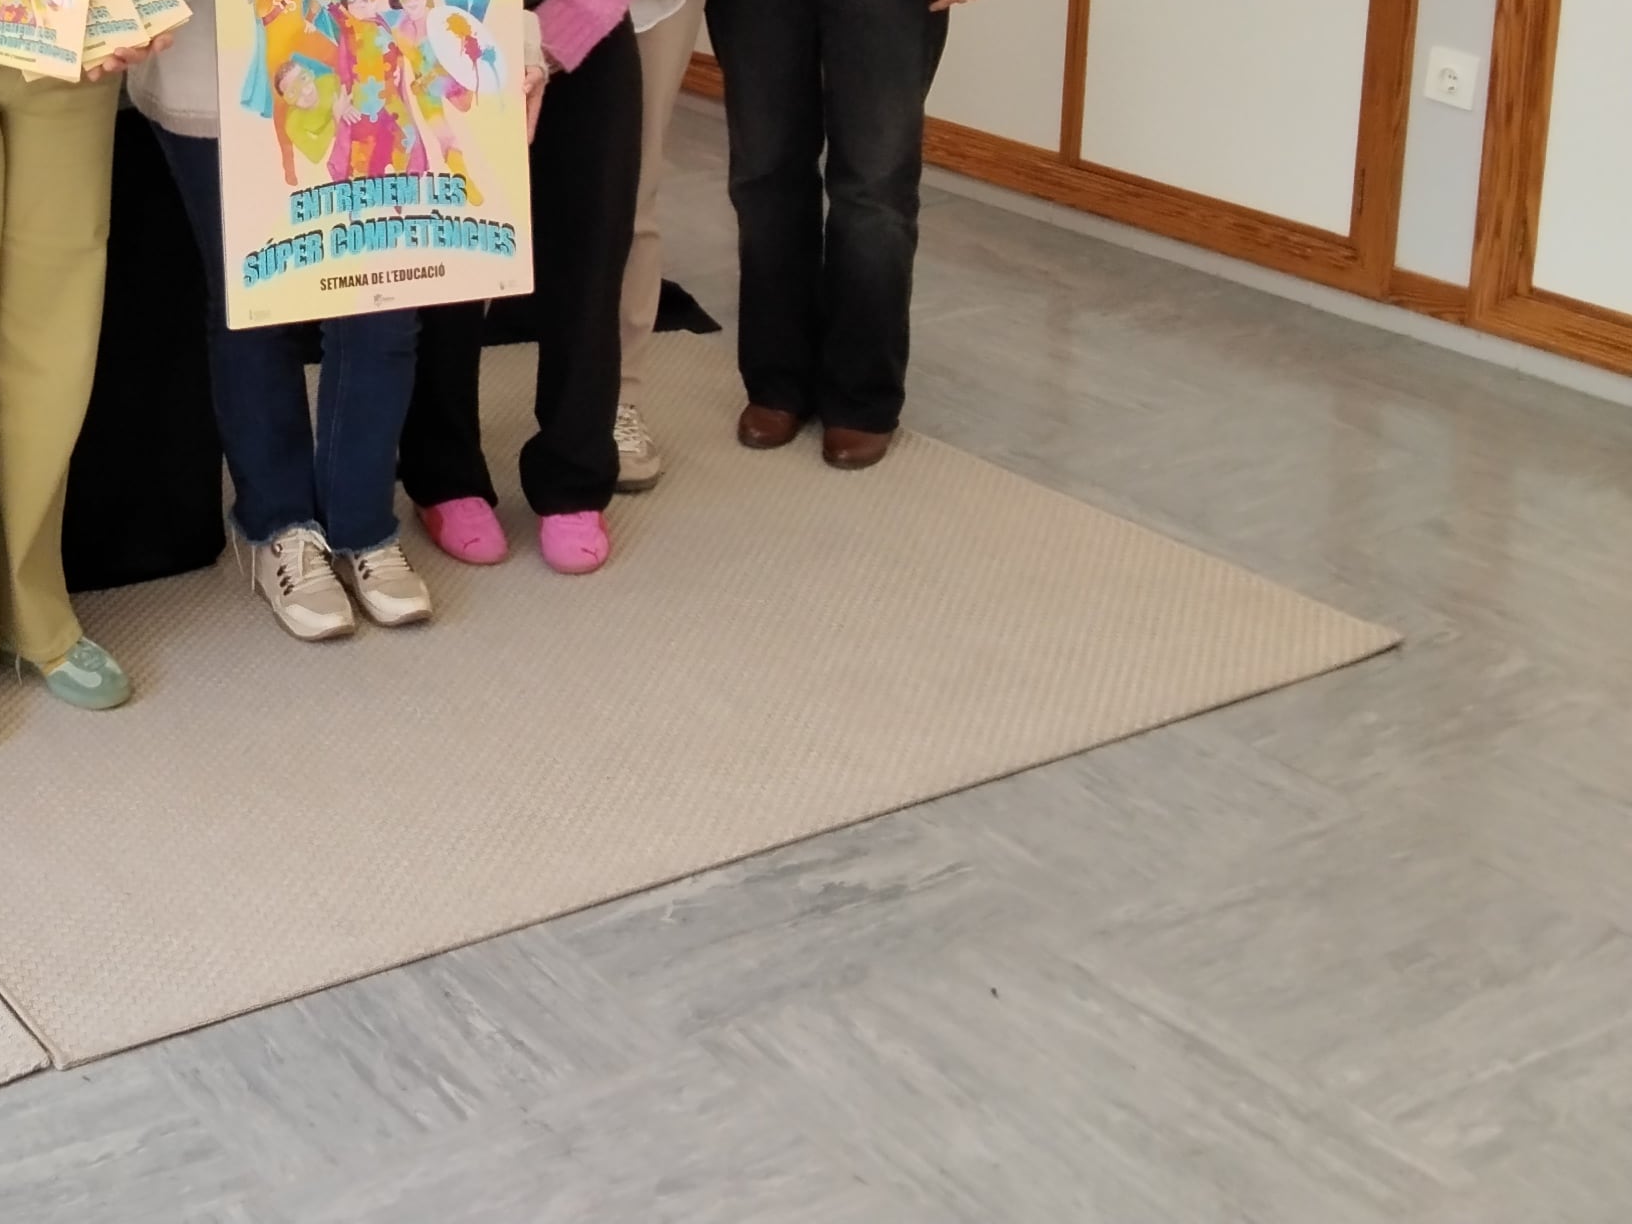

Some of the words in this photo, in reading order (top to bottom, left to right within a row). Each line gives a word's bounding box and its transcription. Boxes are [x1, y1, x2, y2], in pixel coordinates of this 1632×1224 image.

[289, 172, 422, 225] ENTRENEM
[425, 172, 468, 207] LES
[242, 231, 325, 289] SÚPER
[330, 209, 517, 258] COMPETÈNCIES
[320, 273, 369, 292] SETMANA
[371, 271, 384, 285] DE
[386, 262, 446, 283] L'EDUCACIÓ
